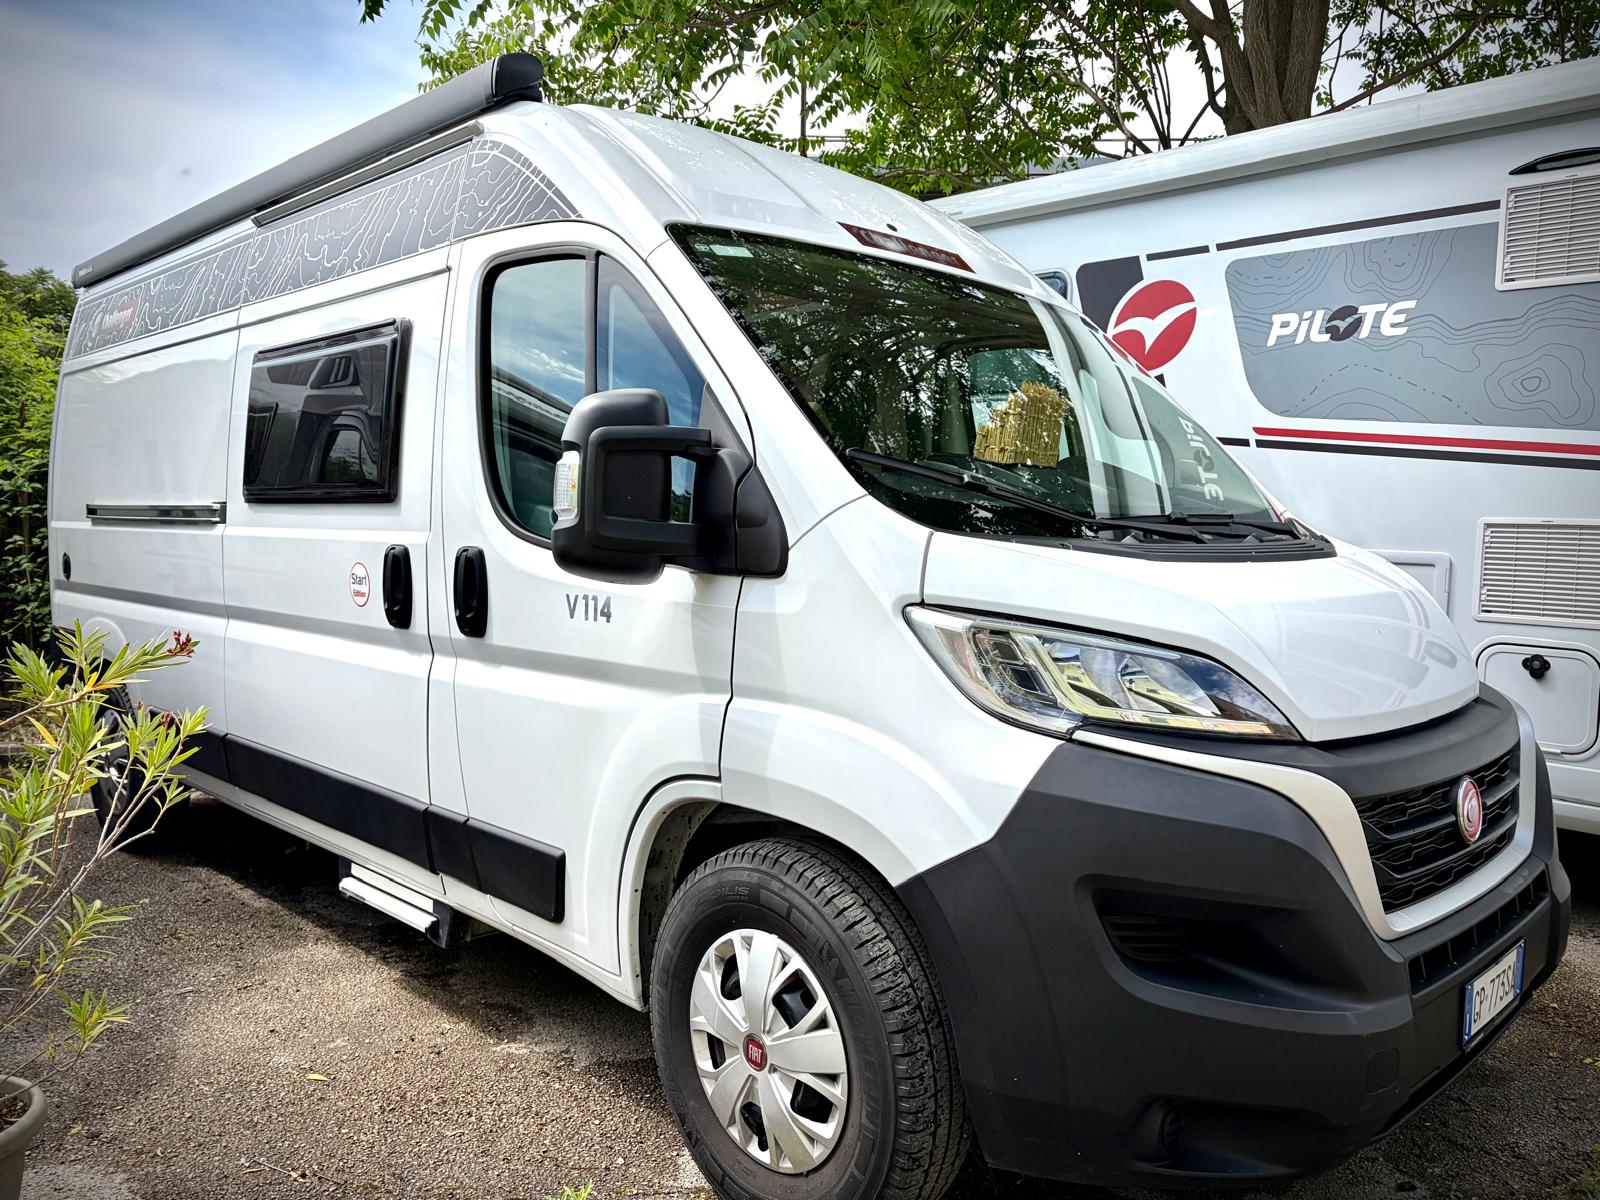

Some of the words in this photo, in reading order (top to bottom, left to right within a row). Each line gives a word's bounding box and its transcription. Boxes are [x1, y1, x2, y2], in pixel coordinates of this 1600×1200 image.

[351, 573, 367, 586] Start
[353, 589, 366, 597] Edition
[565, 593, 612, 623] V114
[748, 1044, 763, 1064] FIAT
